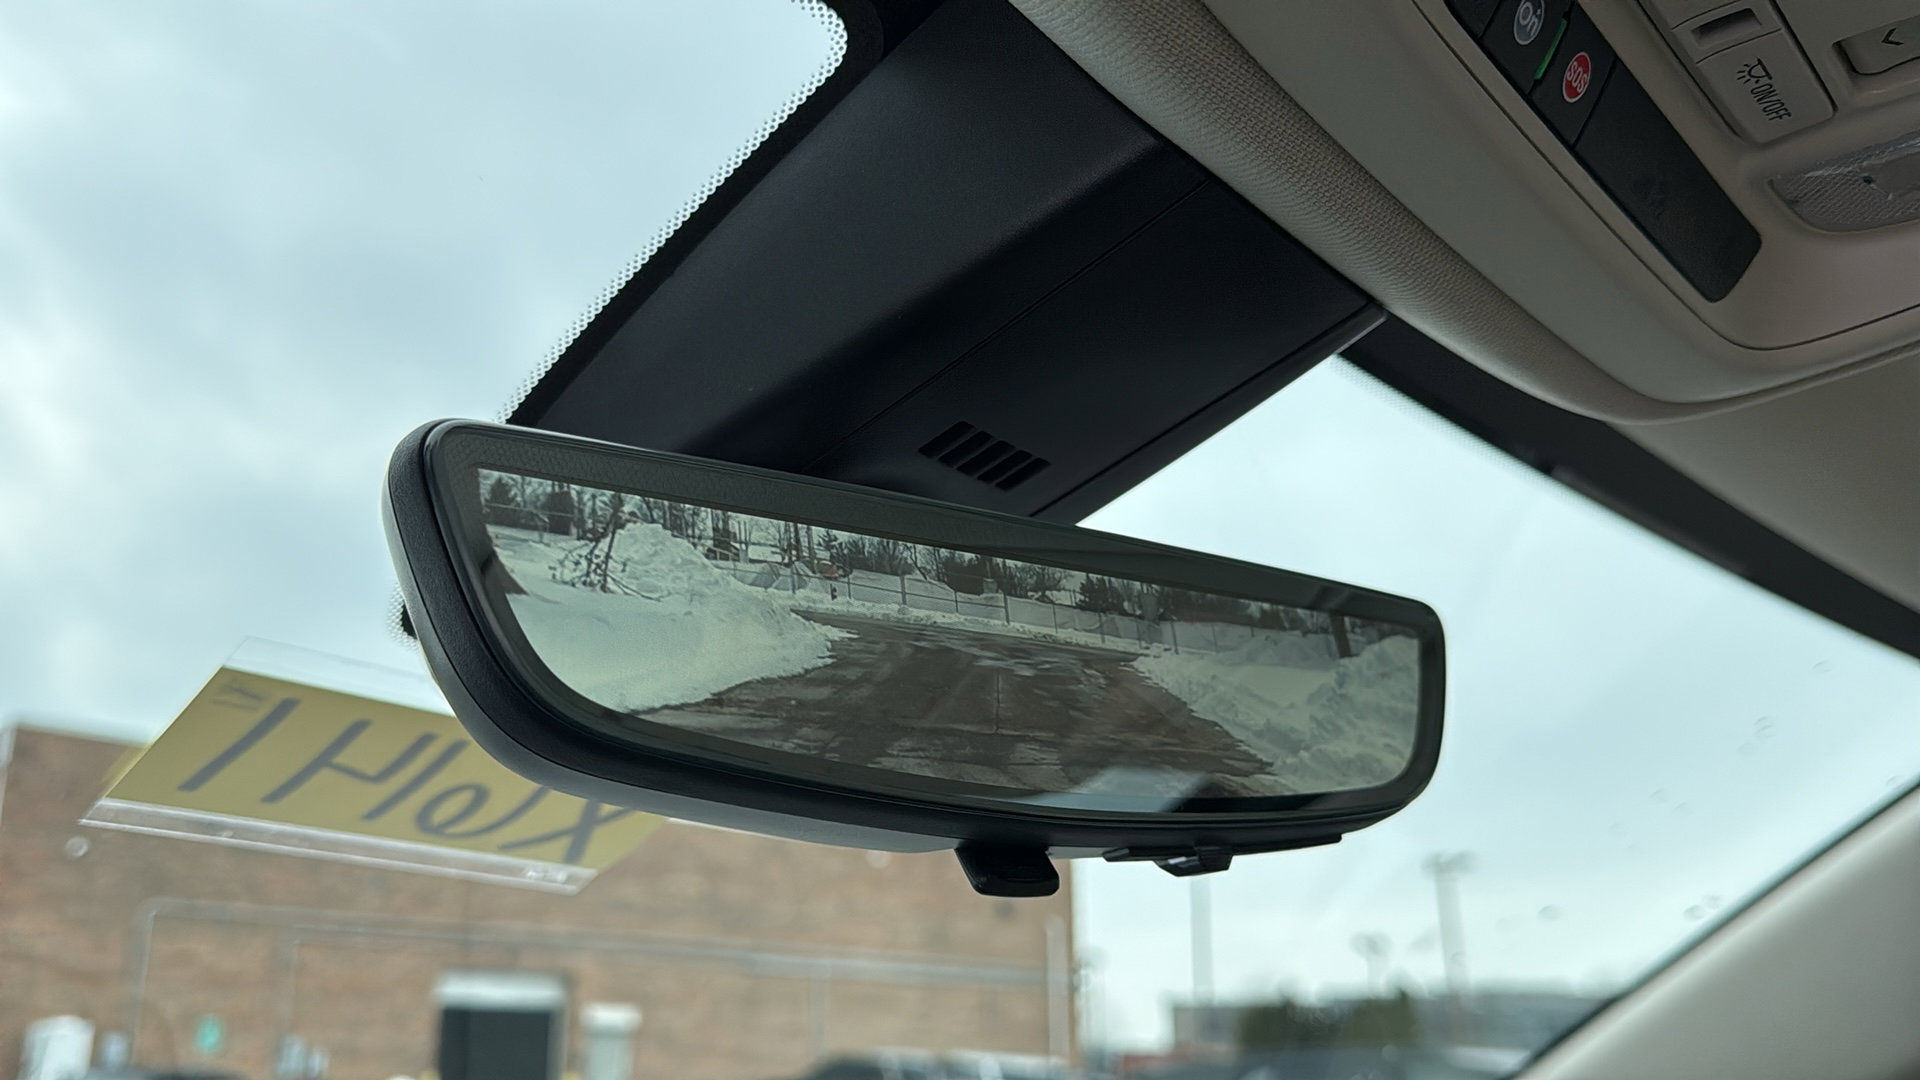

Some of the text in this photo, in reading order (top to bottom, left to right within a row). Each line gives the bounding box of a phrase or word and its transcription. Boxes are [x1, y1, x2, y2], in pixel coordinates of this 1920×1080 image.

[1519, 1, 1538, 36] On
[1567, 61, 1587, 93] SOS
[1751, 83, 1791, 120] ON/OFF
